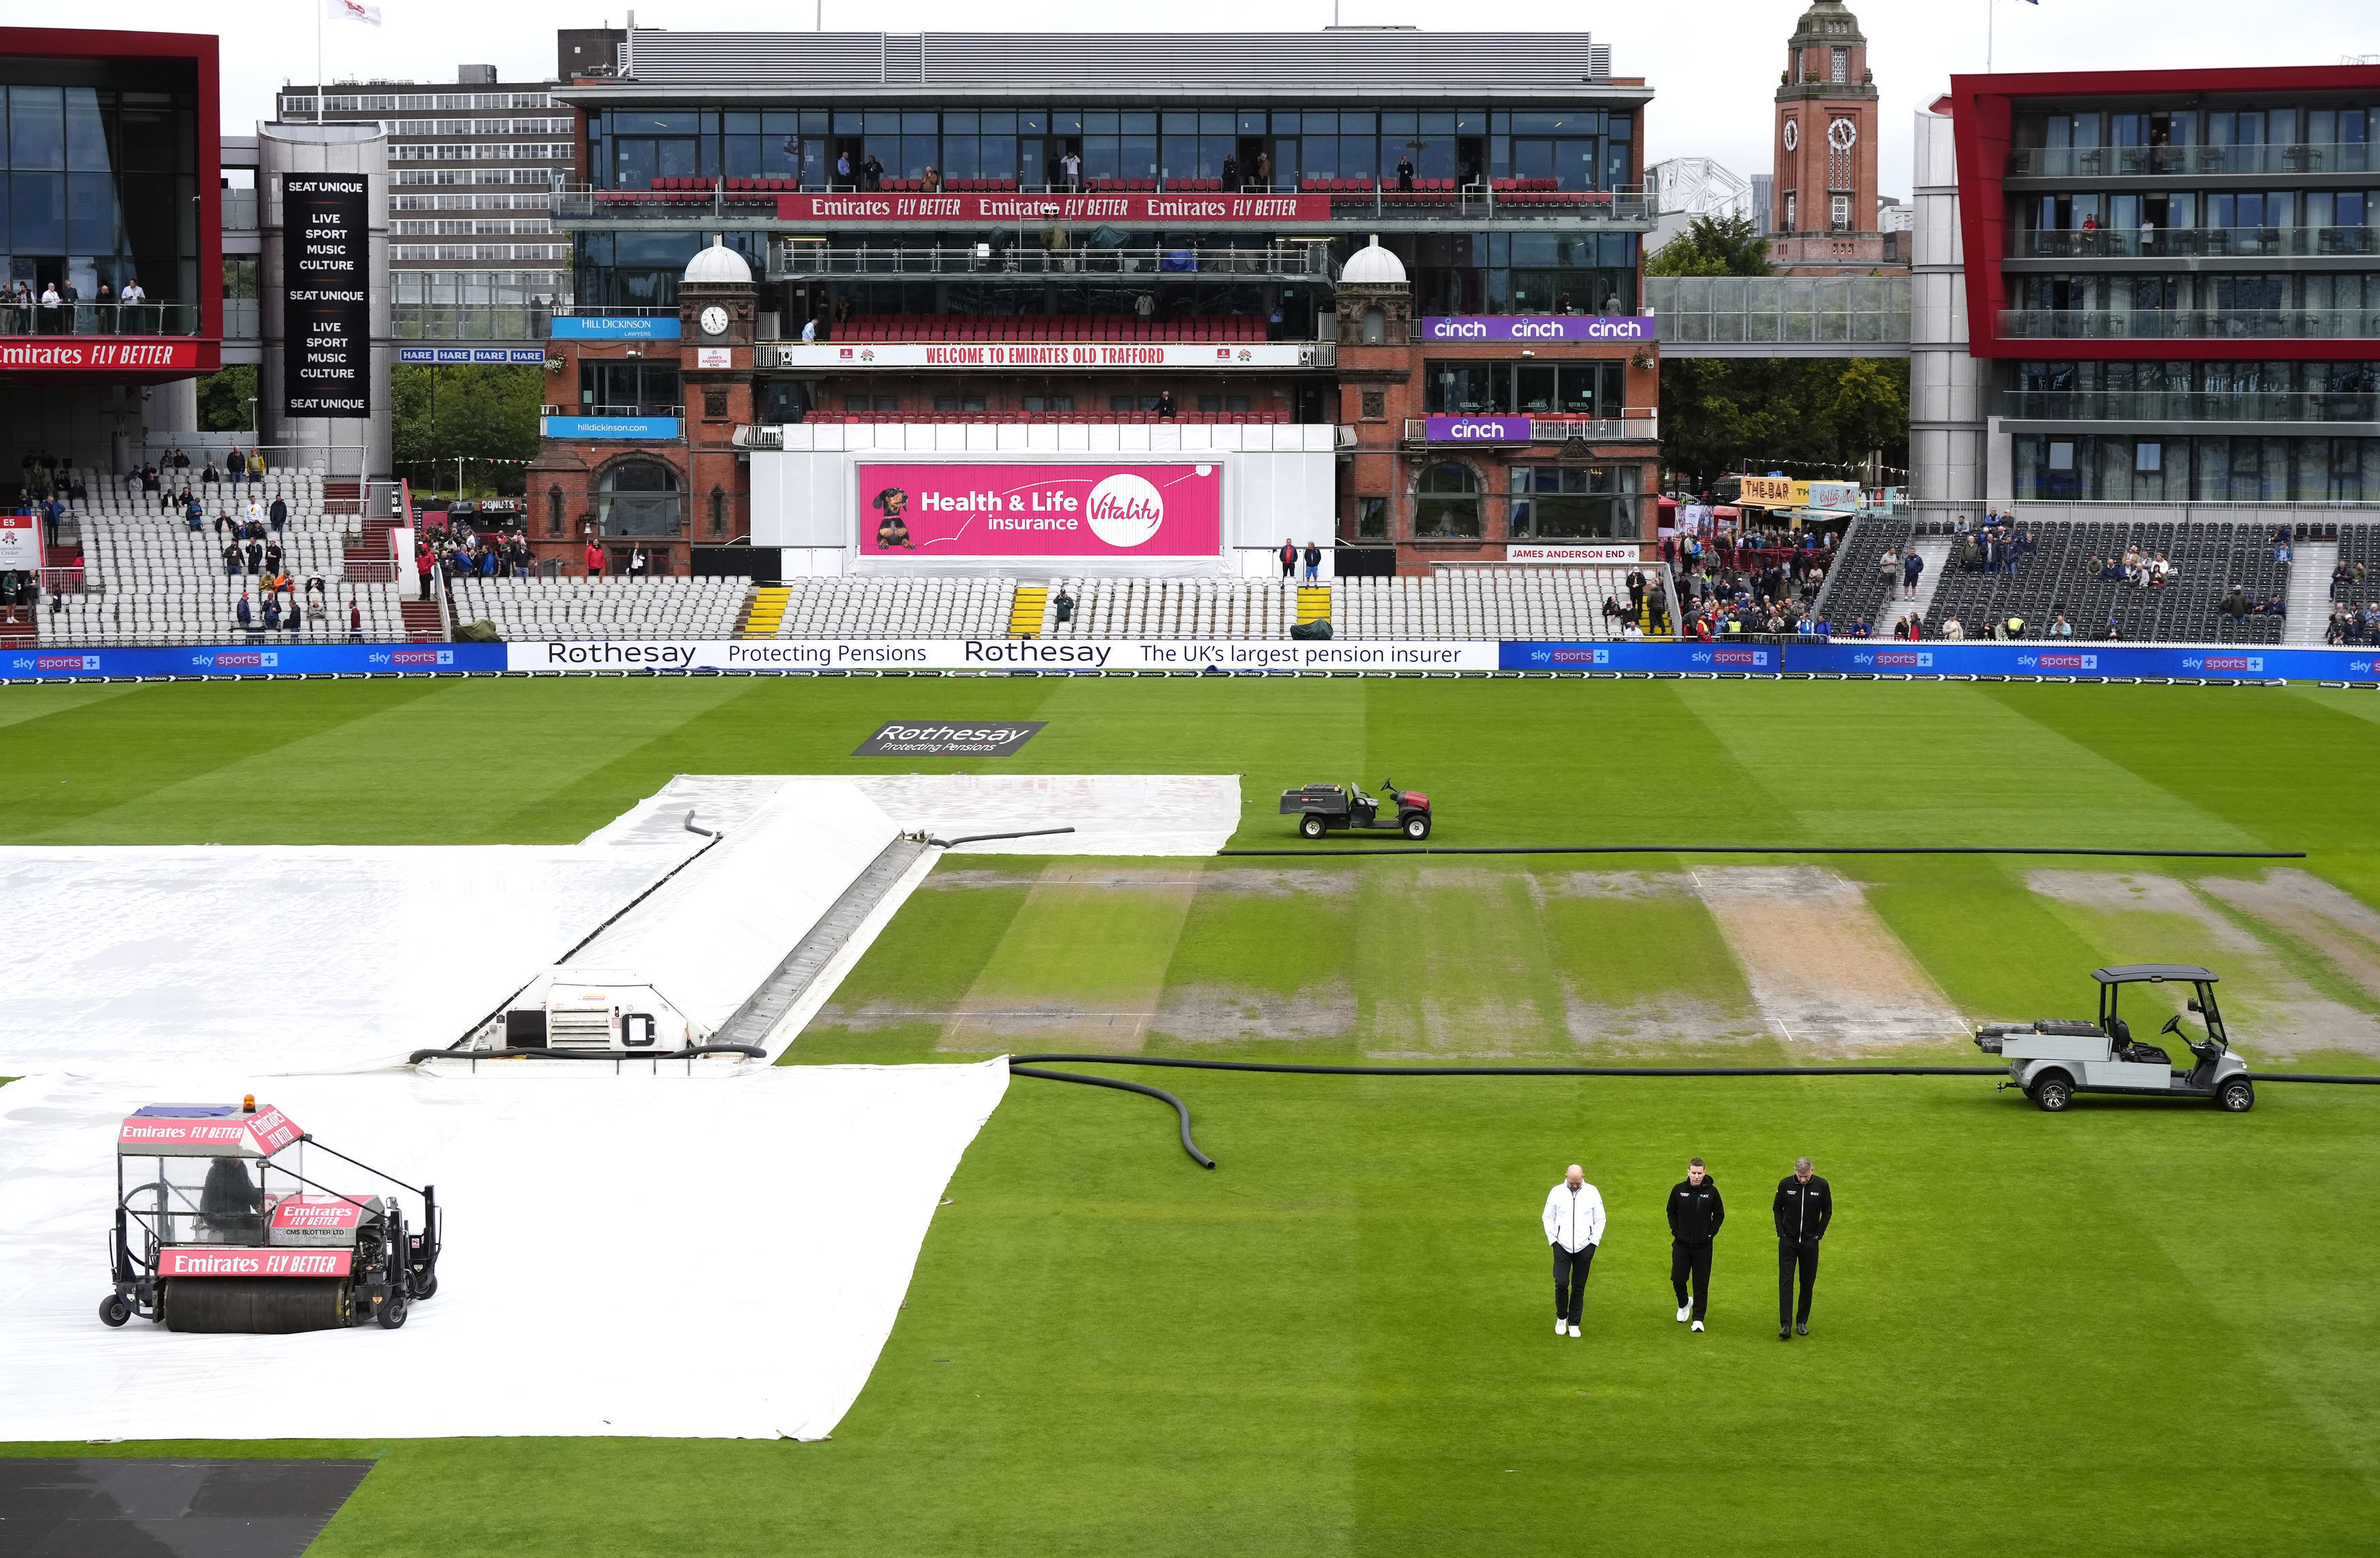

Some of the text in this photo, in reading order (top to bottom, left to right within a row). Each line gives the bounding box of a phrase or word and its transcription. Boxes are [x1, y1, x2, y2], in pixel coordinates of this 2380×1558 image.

[289, 182, 362, 193] SEAT UNIQUE
[812, 199, 960, 215] Emirates FLY BETTER
[1065, 199, 1085, 215] FLY
[1088, 199, 1127, 215] BETTER
[1147, 199, 1296, 216] Emirates FLY BETTER
[313, 214, 340, 223] LIVE
[306, 229, 347, 239] SPORT
[307, 245, 345, 254] MUSIC
[300, 260, 354, 270] CULTURE
[290, 291, 363, 301] SEAT UNIQUE
[313, 323, 341, 331] LIVE
[582, 320, 651, 328] HILL DICKINSON
[1435, 318, 1486, 337] cinch
[1512, 318, 1563, 337] cinch
[1589, 318, 1640, 337] cinch
[307, 338, 348, 347] SPORT
[91, 345, 116, 364] FLY
[120, 345, 173, 364] BETTER
[308, 354, 346, 362] MUSIC
[927, 348, 1163, 363] WELCOME TO EMIRATES OLD TRAFFORD
[301, 369, 354, 378] CULTURE
[291, 399, 364, 409] SEAT UNIQUE
[1452, 419, 1503, 437] cinch
[1746, 481, 1789, 499] THE BAR
[1796, 488, 1809, 496] TH
[481, 500, 515, 509] DONUTS
[922, 491, 1078, 511] Health & Life
[1090, 492, 1160, 528] Vitality
[989, 514, 1078, 530] insurance
[369, 652, 390, 664] sky
[395, 654, 435, 664] sports
[549, 641, 1461, 667] Rothesay Protecting Pensions Rothesay The UK's largest pension insurer
[1531, 650, 1551, 662] sky
[1555, 651, 1591, 662] sports
[1692, 651, 1712, 663] sky
[1716, 653, 1751, 663] sports
[1854, 654, 1874, 665] sky
[1878, 655, 1915, 664] sports
[13, 658, 35, 670] sky
[39, 658, 80, 669] sports
[192, 655, 214, 666] sky
[218, 656, 258, 666] sports
[2018, 655, 2037, 667] sky
[2041, 657, 2079, 666] sports
[2183, 658, 2203, 669] sky
[2207, 659, 2245, 669] sports
[2350, 660, 2371, 673] sky
[877, 726, 1029, 745] Rothesay
[880, 743, 943, 752] Protecting
[247, 1108, 285, 1136] Emirates
[124, 1126, 243, 1139] Emirates FLY BETTER
[267, 1125, 294, 1149] FLY BETTER
[284, 1206, 352, 1217] Emirates
[290, 1217, 306, 1225] FLY
[175, 1255, 337, 1272] Emirates FLY BETTER
